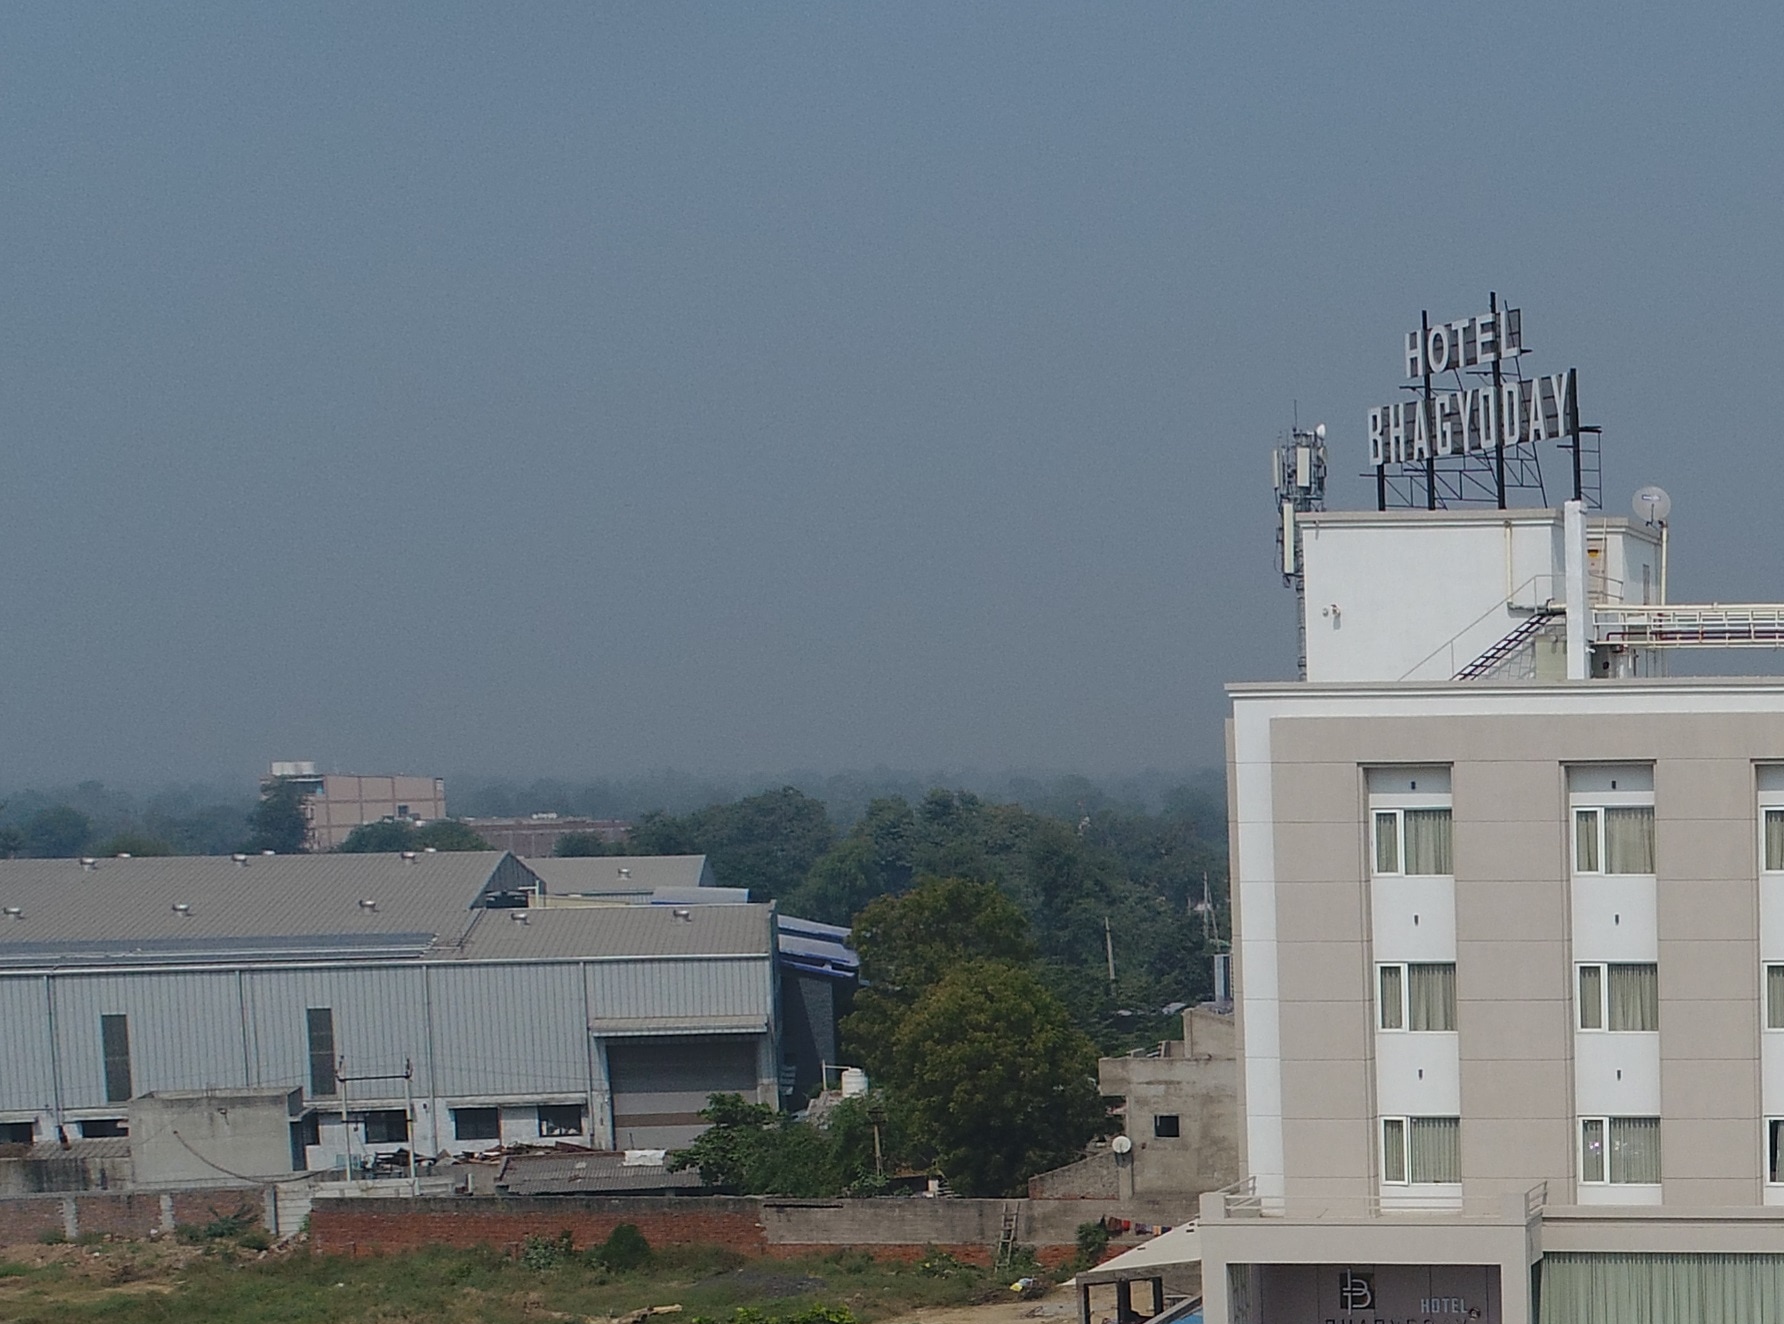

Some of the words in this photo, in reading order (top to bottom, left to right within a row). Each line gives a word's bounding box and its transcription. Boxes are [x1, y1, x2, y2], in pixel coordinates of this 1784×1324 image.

[1404, 309, 1520, 378] HOTEL
[1368, 372, 1569, 466] BHAGYODAY
[1421, 1298, 1468, 1313] HOTEL
